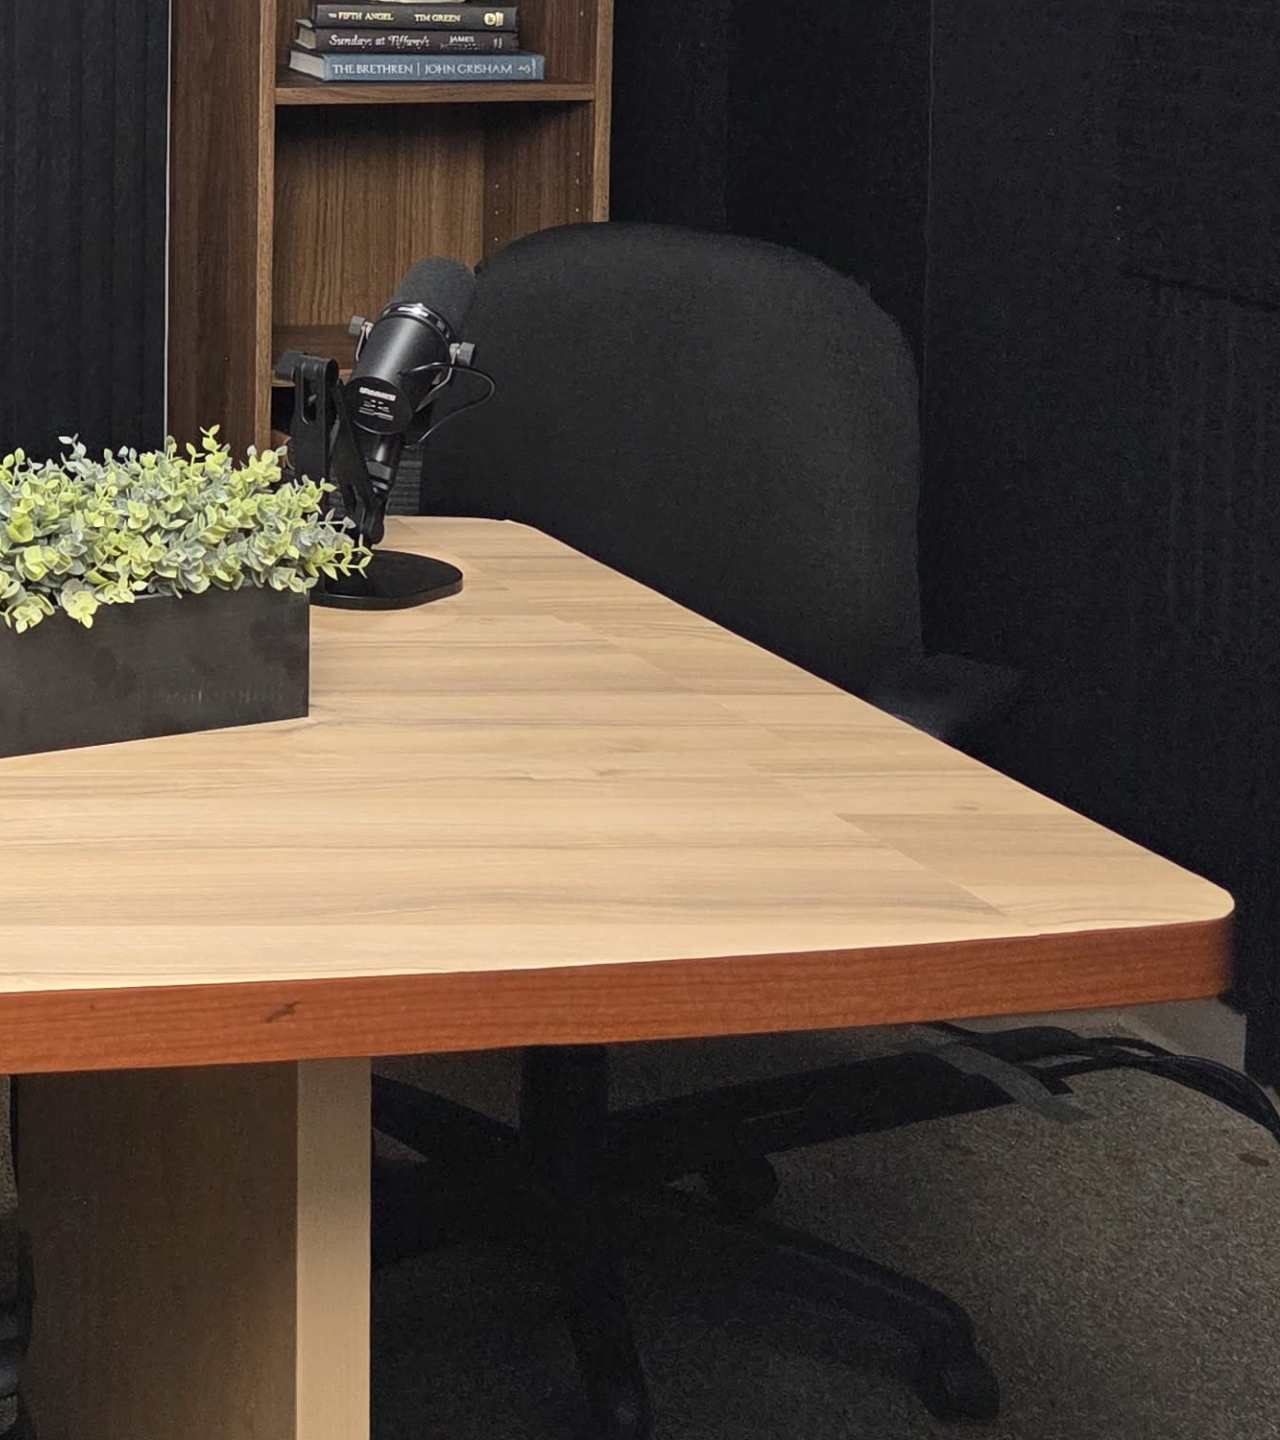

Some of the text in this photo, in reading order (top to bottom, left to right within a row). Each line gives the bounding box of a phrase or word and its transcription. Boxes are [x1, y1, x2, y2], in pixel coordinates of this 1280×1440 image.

[338, 12, 362, 20] FIFTH
[365, 13, 394, 21] ANGEL
[414, 14, 431, 22] TIM
[329, 34, 373, 49] Sundays
[375, 37, 386, 46] at
[449, 35, 475, 44] JAMES
[332, 63, 513, 75] THE BRETHREN JOHN GRISHAM
